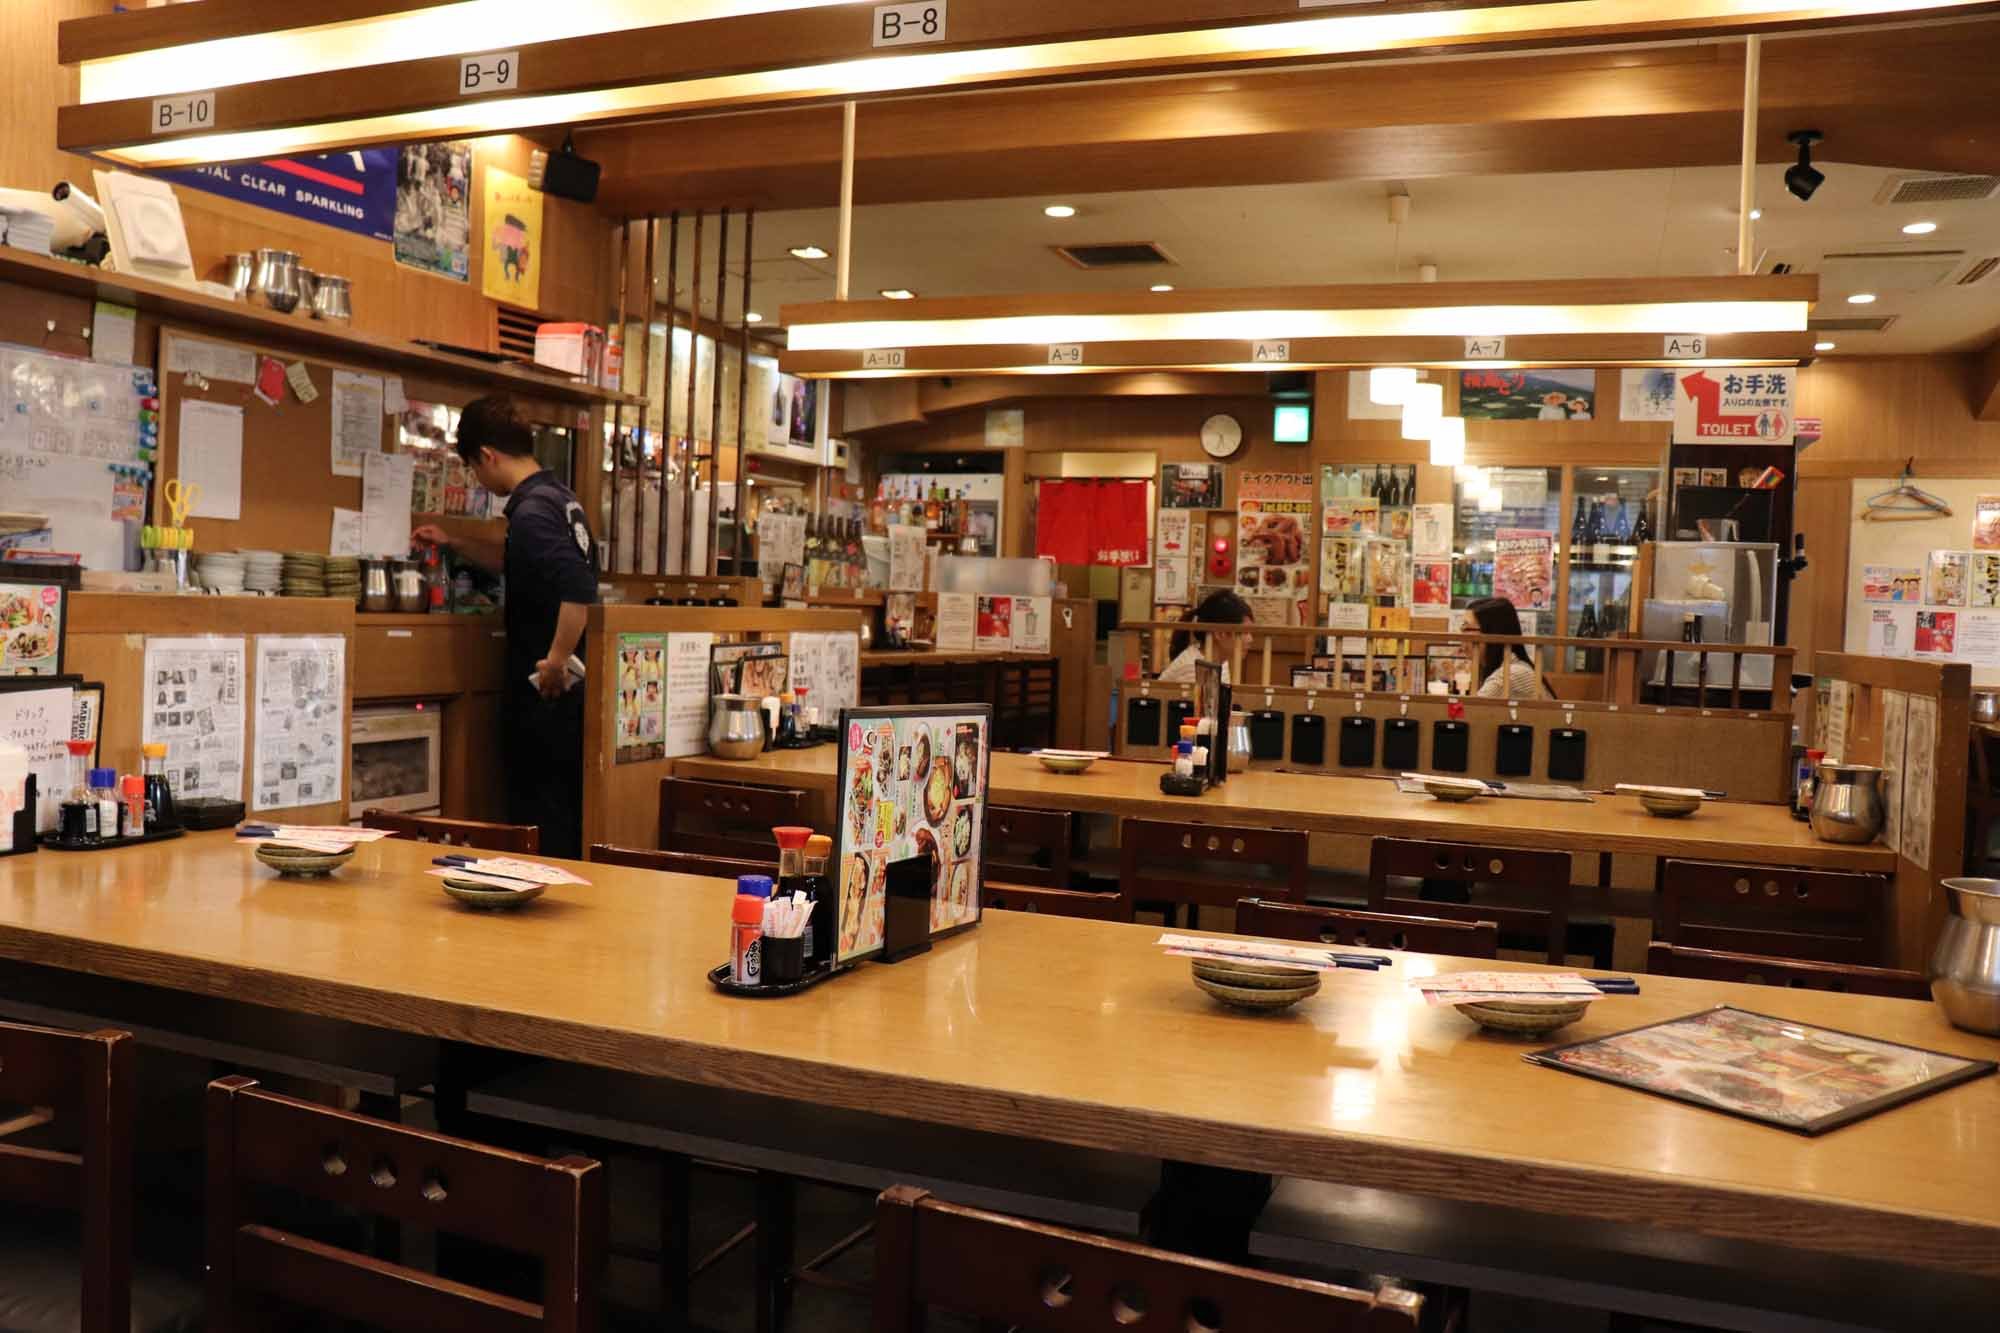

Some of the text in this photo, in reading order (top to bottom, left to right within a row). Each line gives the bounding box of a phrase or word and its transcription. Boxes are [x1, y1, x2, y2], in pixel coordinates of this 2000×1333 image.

[881, 8, 939, 38] B-8
[464, 59, 510, 88] B-9
[159, 99, 208, 126] B-10
[240, 173, 286, 197] CLEAR
[295, 189, 364, 220] SPARKLING
[1256, 344, 1286, 360] A-8
[1468, 340, 1502, 355] A-7
[1668, 339, 1702, 354] A-6
[867, 353, 901, 366] A-10
[1051, 348, 1080, 362] A-9
[1722, 373, 1787, 395] お手洗
[1701, 423, 1752, 436] TOILET
